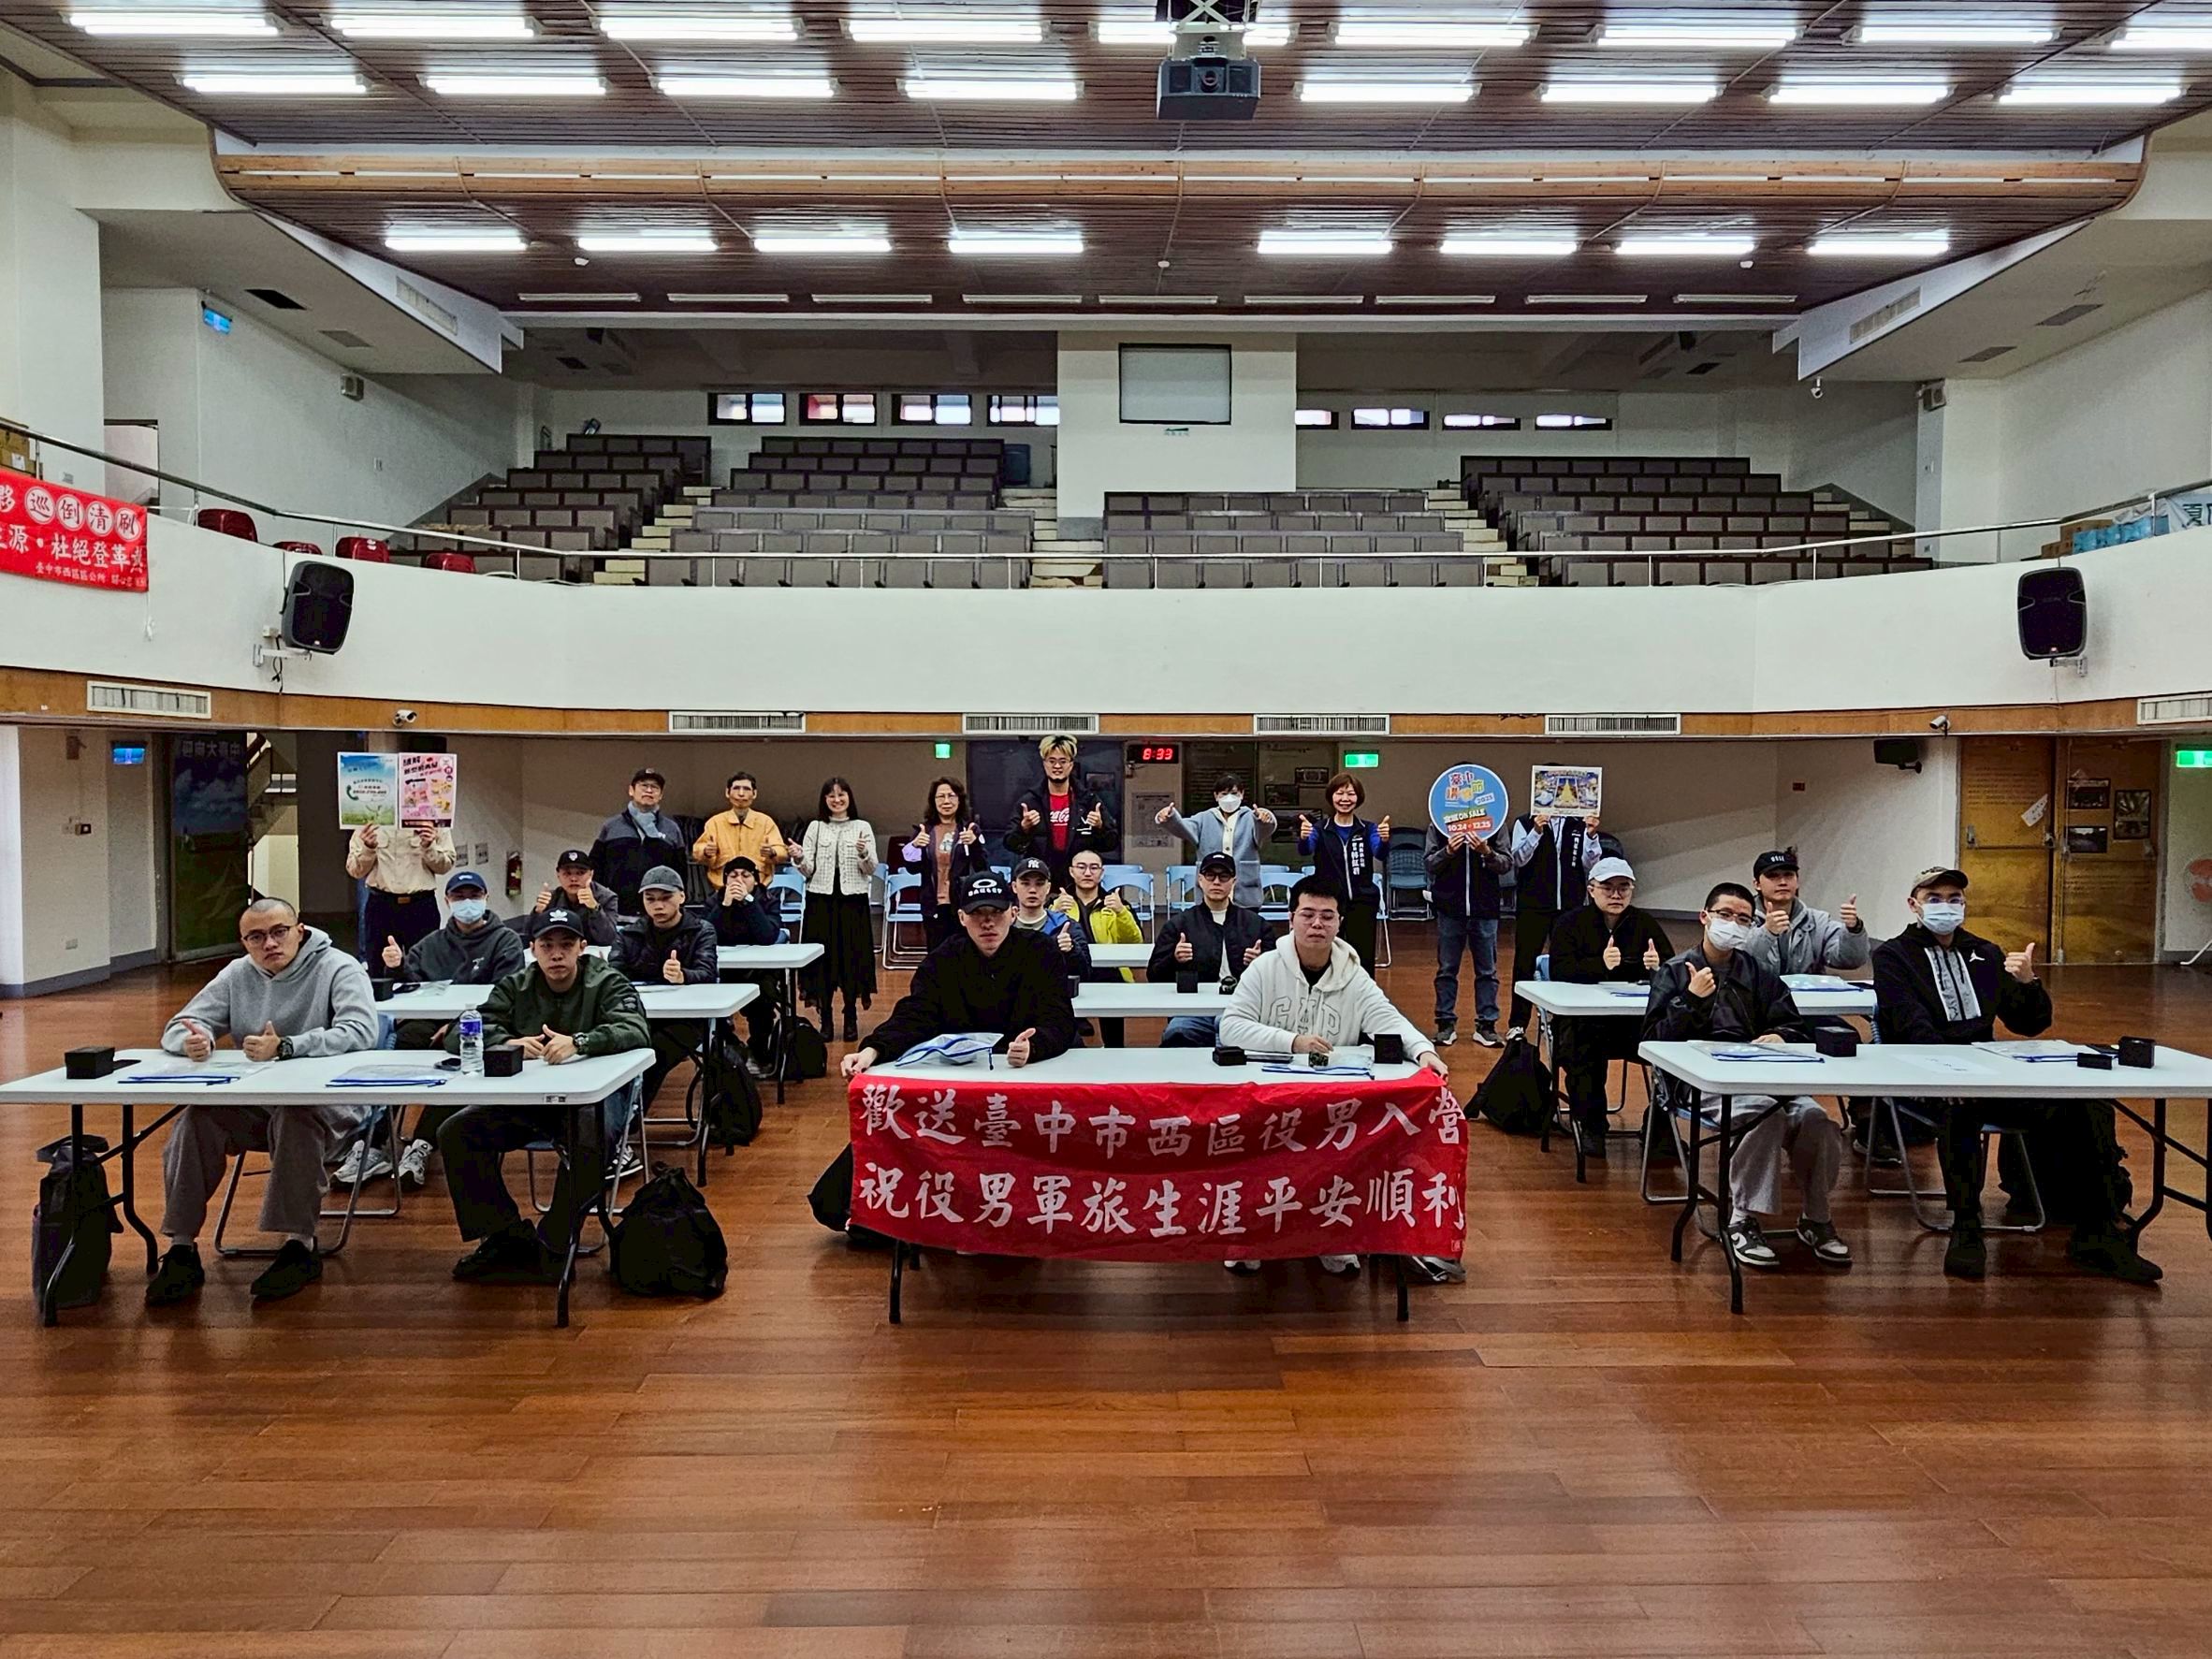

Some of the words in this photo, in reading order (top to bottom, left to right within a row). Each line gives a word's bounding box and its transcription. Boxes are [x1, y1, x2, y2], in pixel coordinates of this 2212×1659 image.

[28, 491, 137, 536] 巡倒清刷
[1142, 748, 1173, 760] 8:33
[860, 1084, 1467, 1159] 歡送臺中市西區役男入營
[859, 1162, 1465, 1238] 祝役男軍旅生涯平安順利
